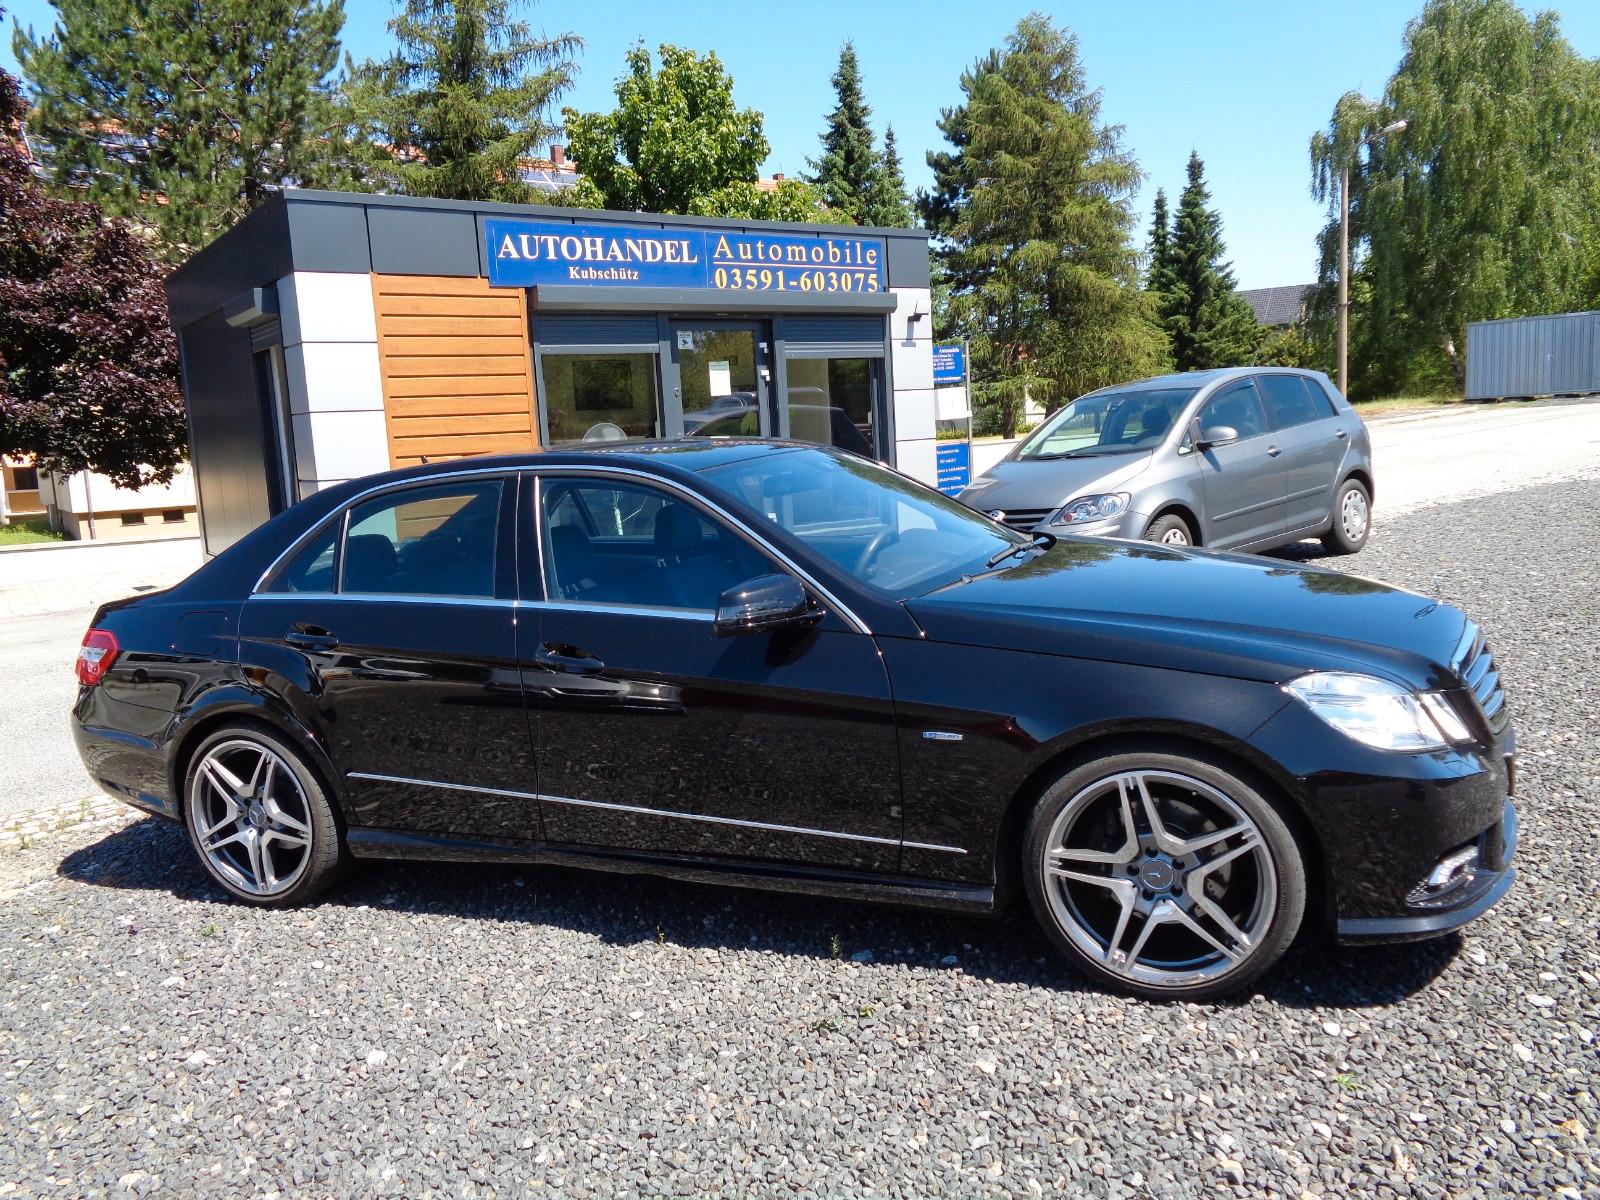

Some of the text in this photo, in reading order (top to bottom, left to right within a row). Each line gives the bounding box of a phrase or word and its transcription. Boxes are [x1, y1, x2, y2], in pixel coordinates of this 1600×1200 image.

[497, 234, 698, 264] AUTOHANDEL
[713, 235, 878, 265] Automobile
[568, 266, 640, 281] Kubschütz
[714, 268, 879, 293] 03591-603075
